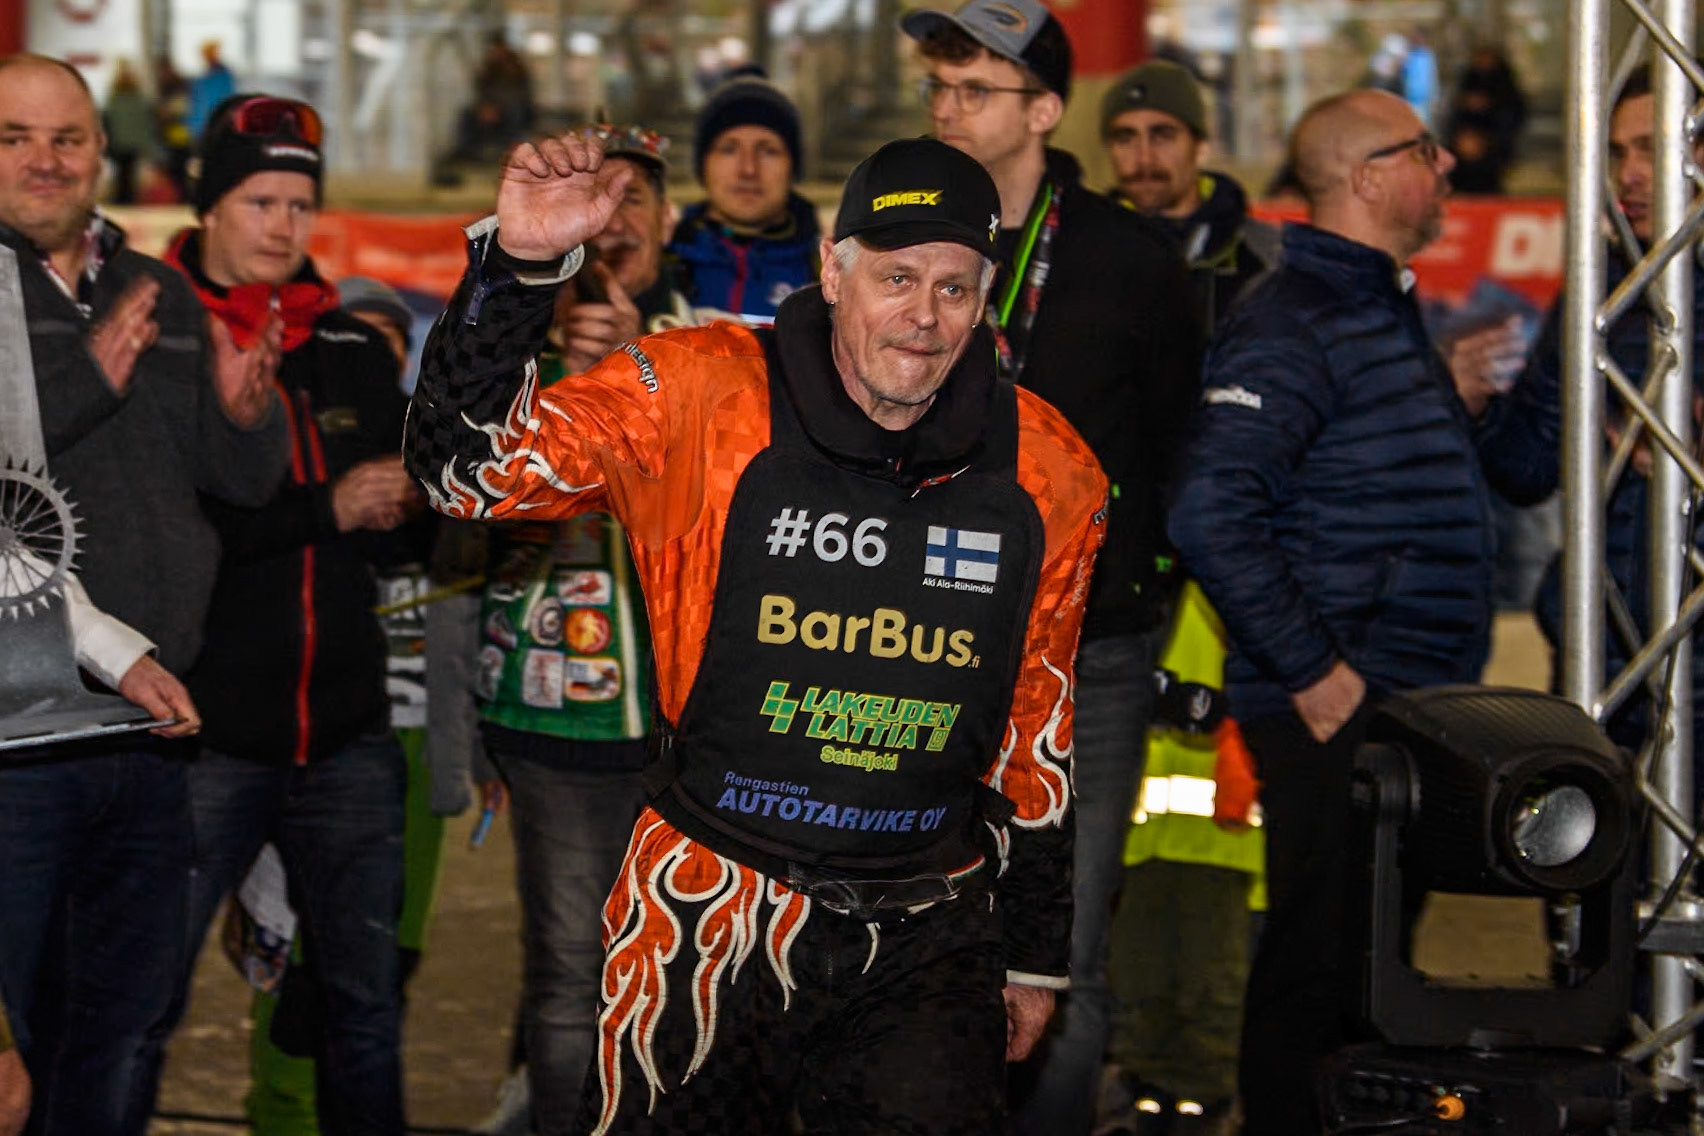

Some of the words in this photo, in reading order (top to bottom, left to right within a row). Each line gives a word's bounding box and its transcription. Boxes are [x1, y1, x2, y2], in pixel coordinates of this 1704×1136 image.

[872, 191, 941, 212] DIMEX
[766, 507, 888, 567] #66
[922, 577, 936, 587] Aki
[936, 579, 994, 595] Ala-Riihimäki
[800, 687, 962, 728] LAKEUDEN
[805, 713, 918, 750] LATTIA
[820, 745, 899, 771] Seinäjoki
[724, 771, 810, 796] Rengastien
[716, 787, 918, 832] AUTOTARVIKE
[919, 805, 947, 831] OY
